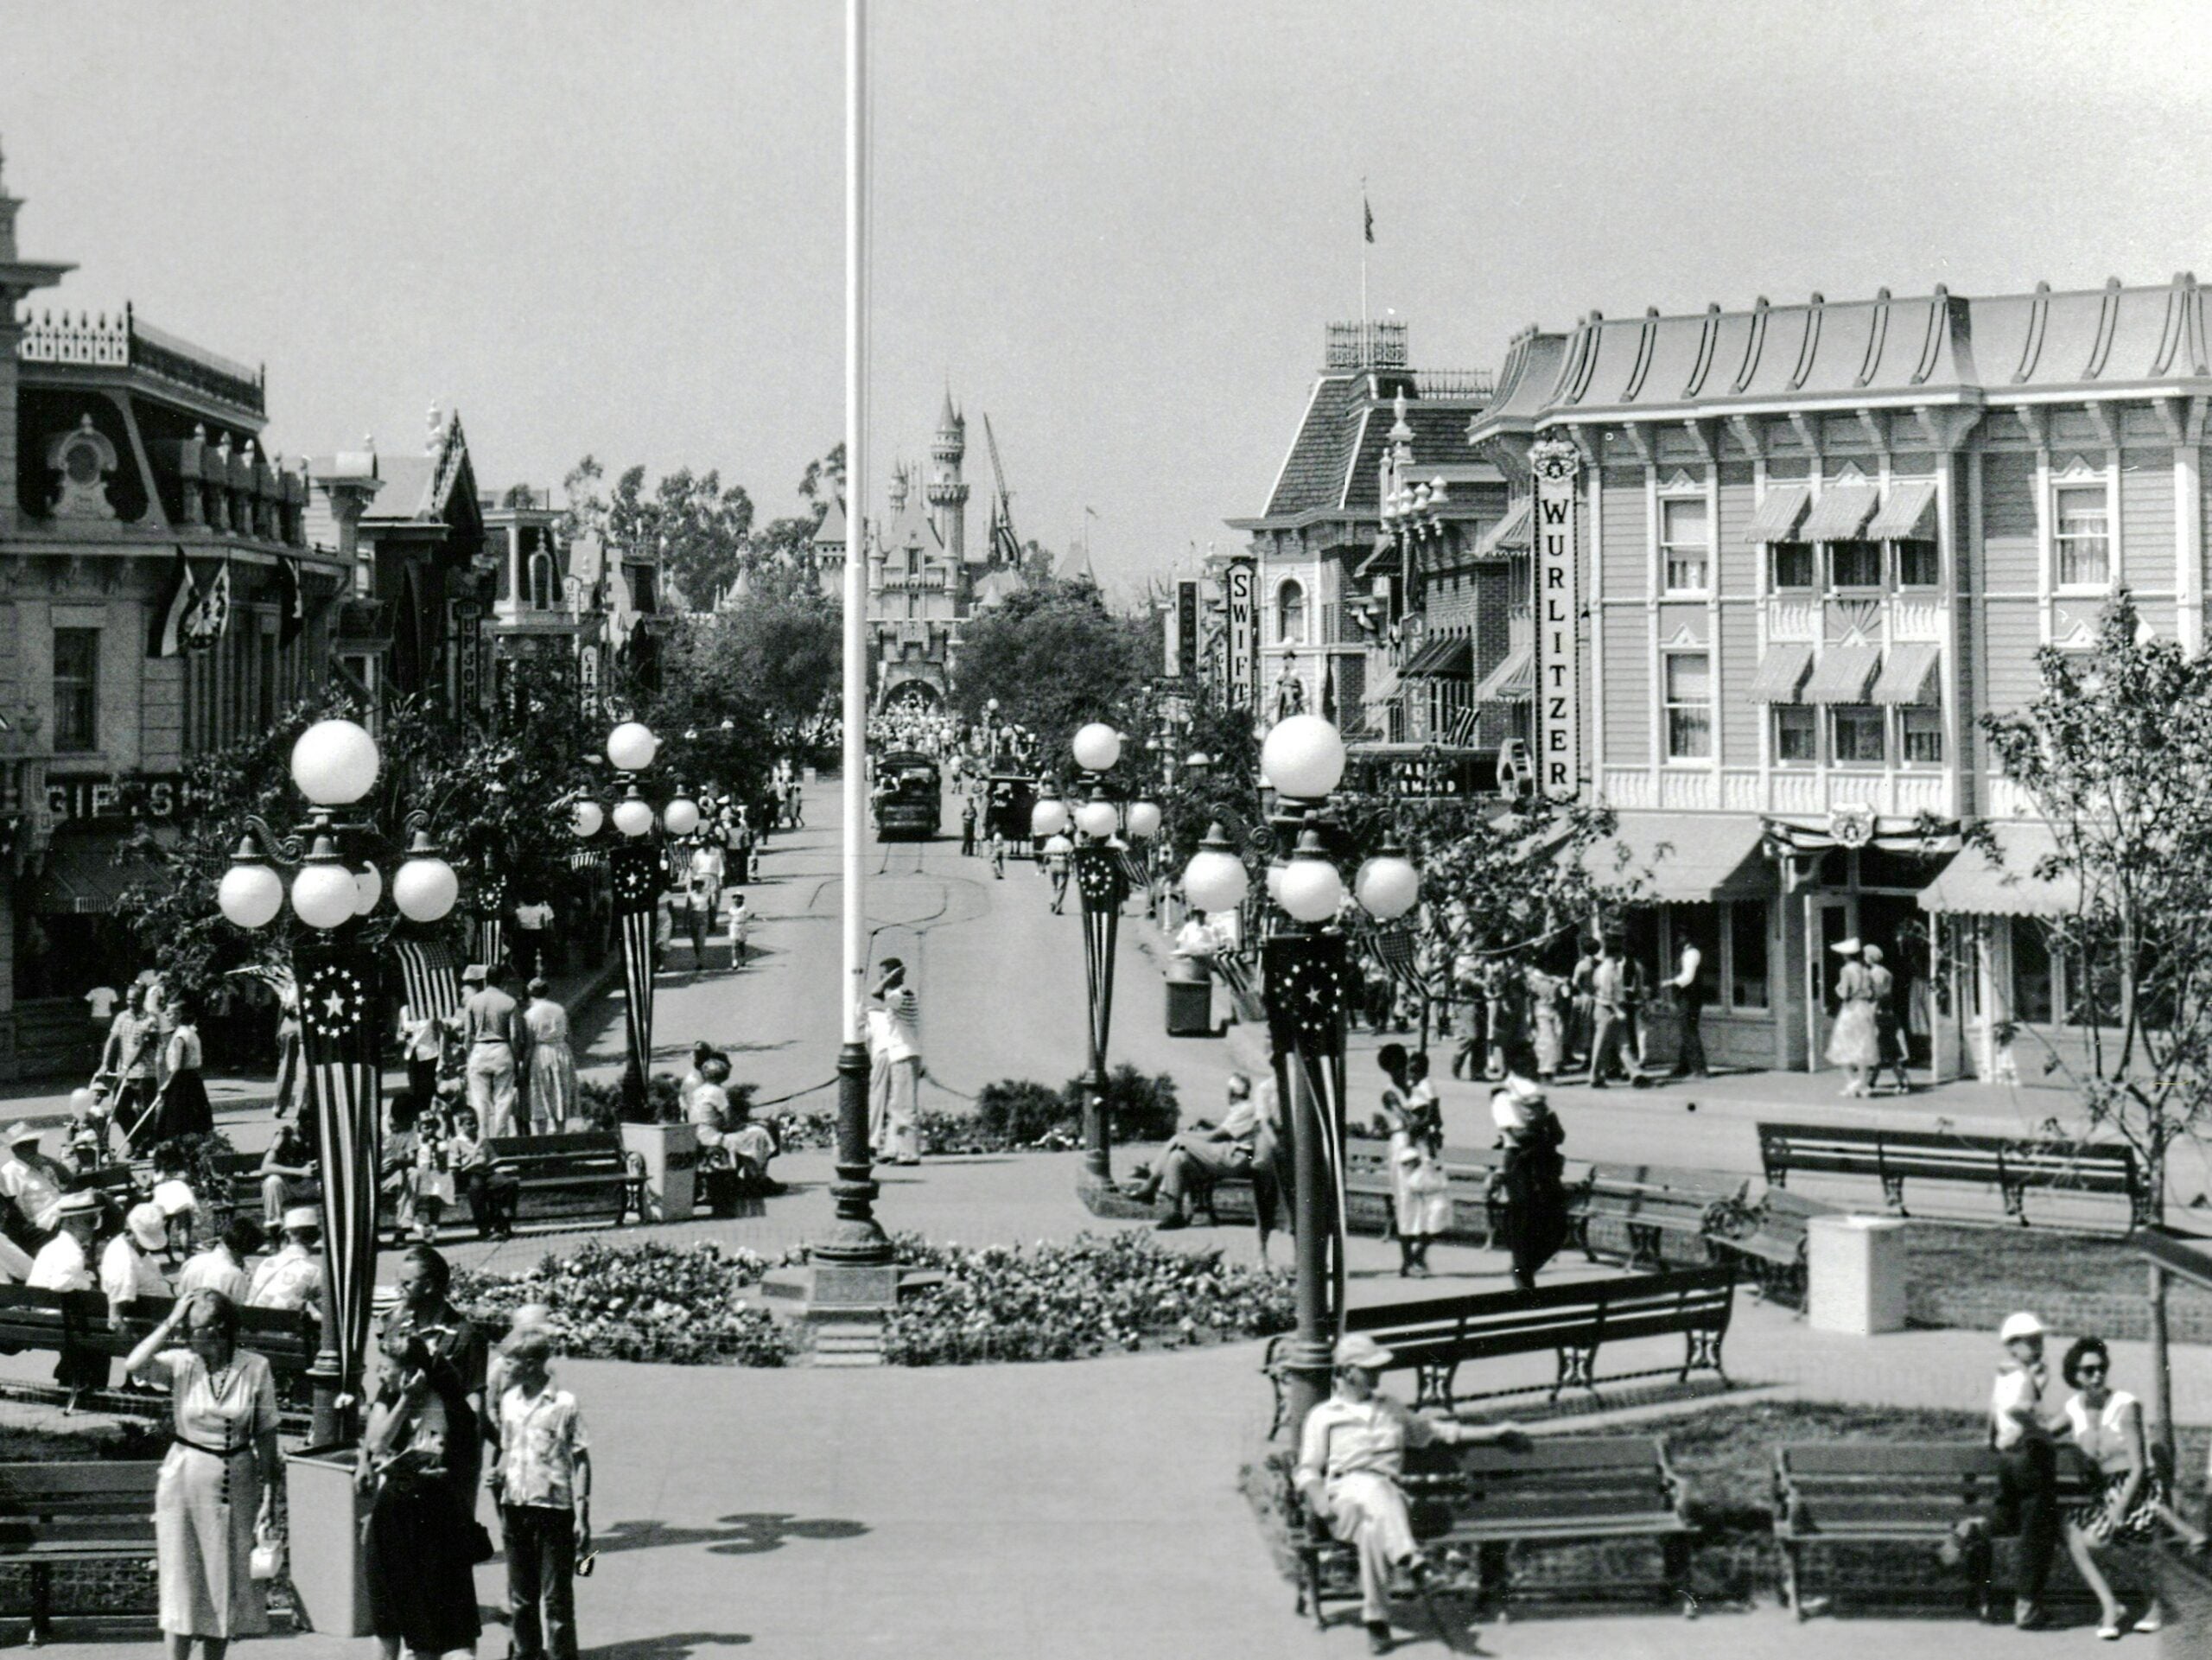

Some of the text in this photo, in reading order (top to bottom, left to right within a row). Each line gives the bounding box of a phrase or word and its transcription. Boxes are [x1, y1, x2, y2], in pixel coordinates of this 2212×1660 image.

[1233, 574, 1249, 702] SWIFT
[1411, 619, 1424, 738] JELRY
[1541, 499, 1569, 785] WURLITZER
